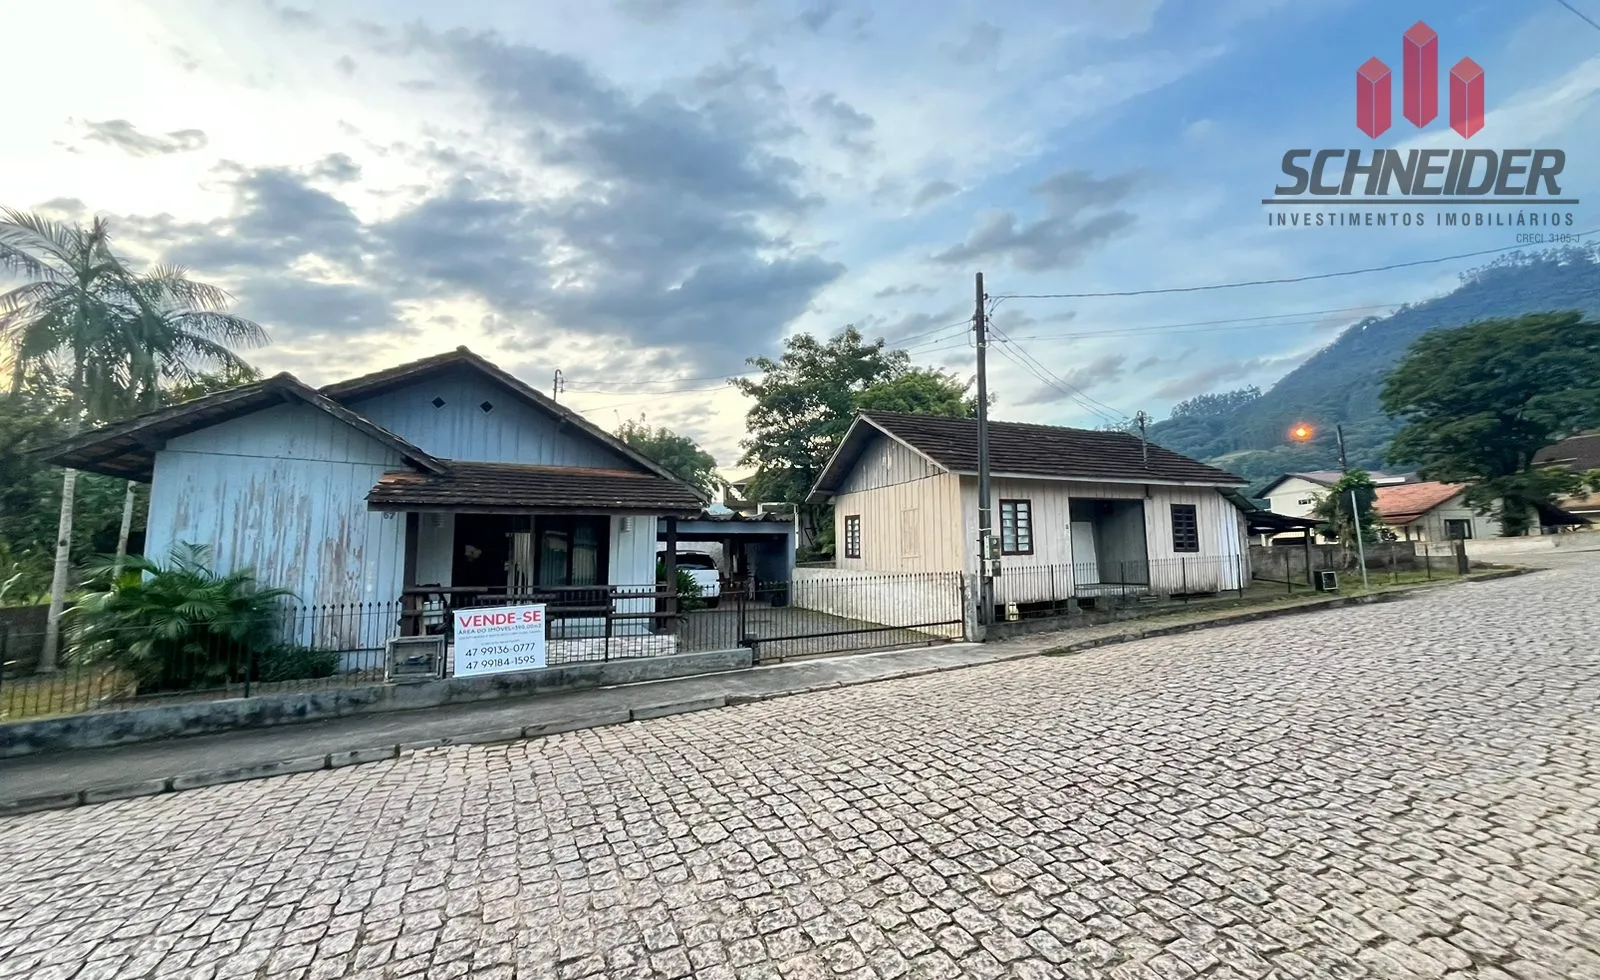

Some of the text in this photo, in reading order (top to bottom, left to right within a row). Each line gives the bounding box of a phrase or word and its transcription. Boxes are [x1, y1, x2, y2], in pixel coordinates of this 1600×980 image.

[459, 611, 541, 627] VENDE-SE
[465, 643, 536, 657] 47 99136-0777
[465, 655, 536, 670] 47 99184-1595
